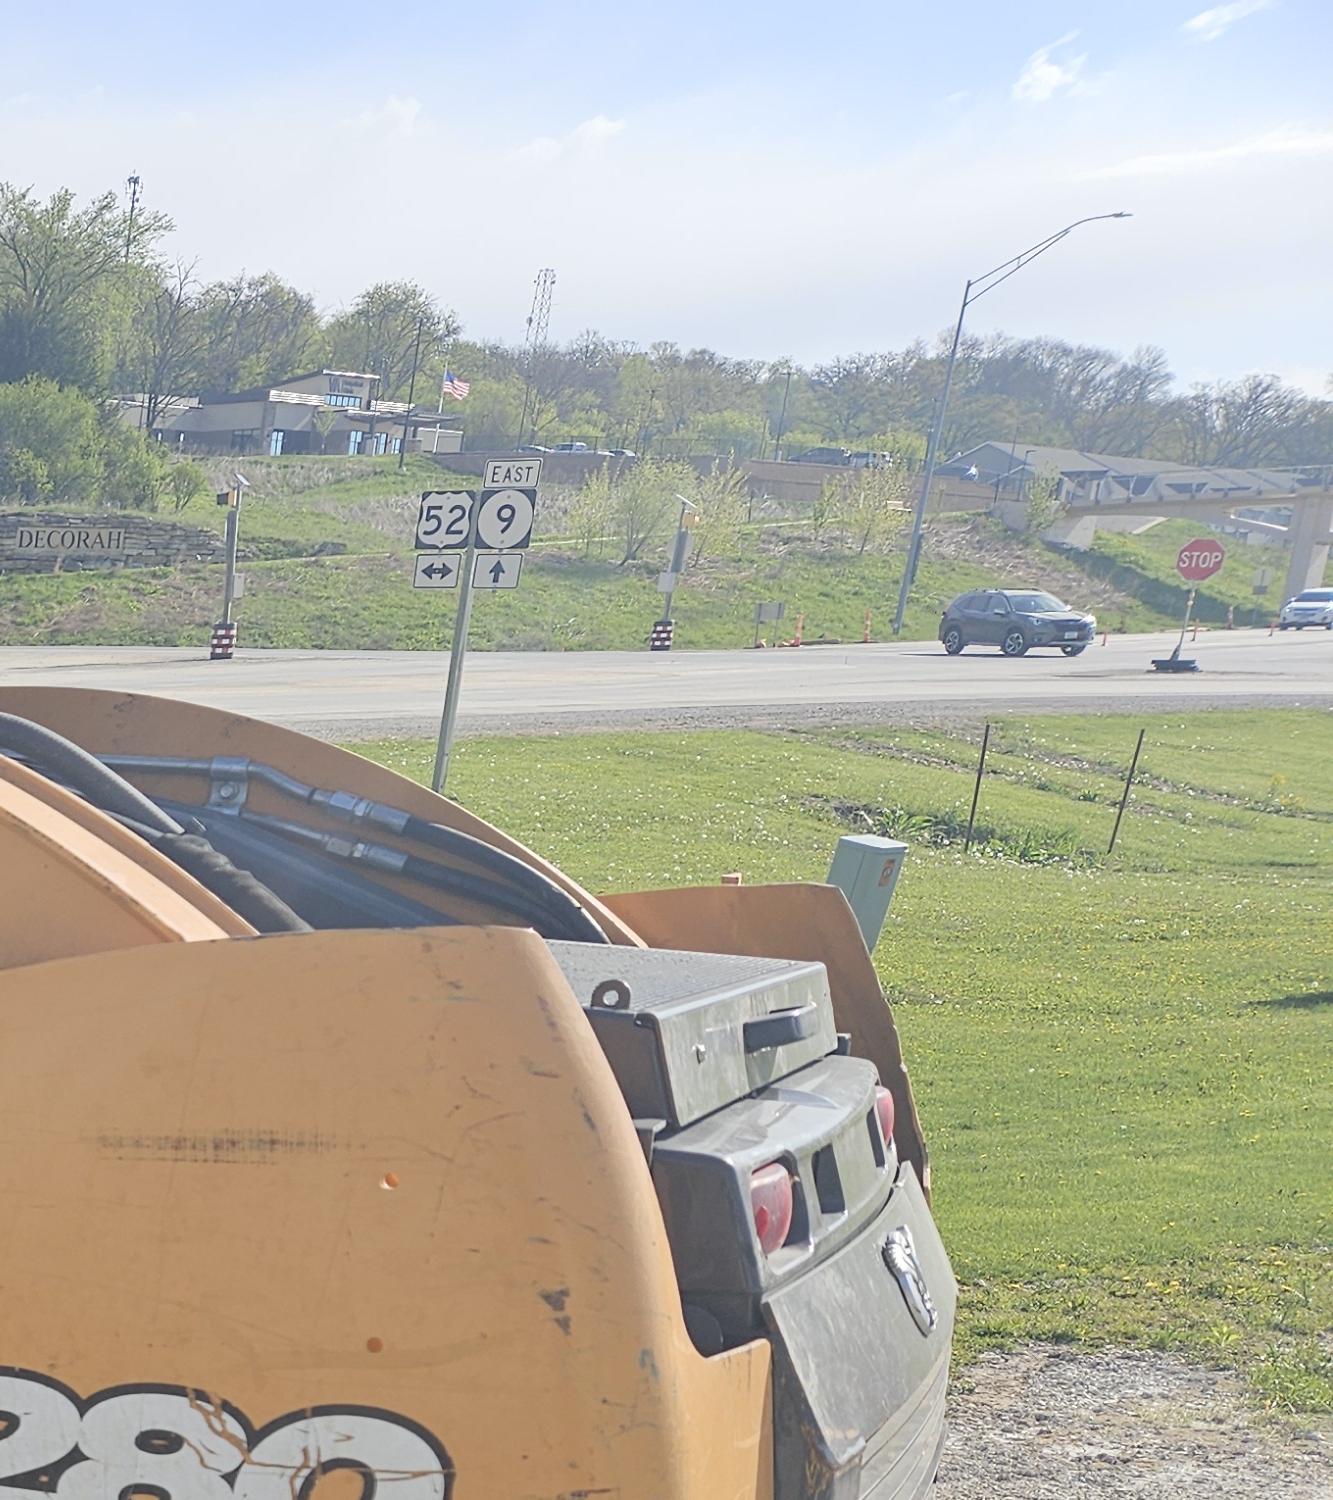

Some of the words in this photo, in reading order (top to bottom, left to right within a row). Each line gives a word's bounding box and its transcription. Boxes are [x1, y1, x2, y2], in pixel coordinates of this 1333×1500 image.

[491, 465, 534, 483] EAST
[422, 504, 467, 536] 52
[496, 503, 516, 534] 9
[17, 529, 122, 550] DECORAH
[1178, 551, 1222, 568] STOP
